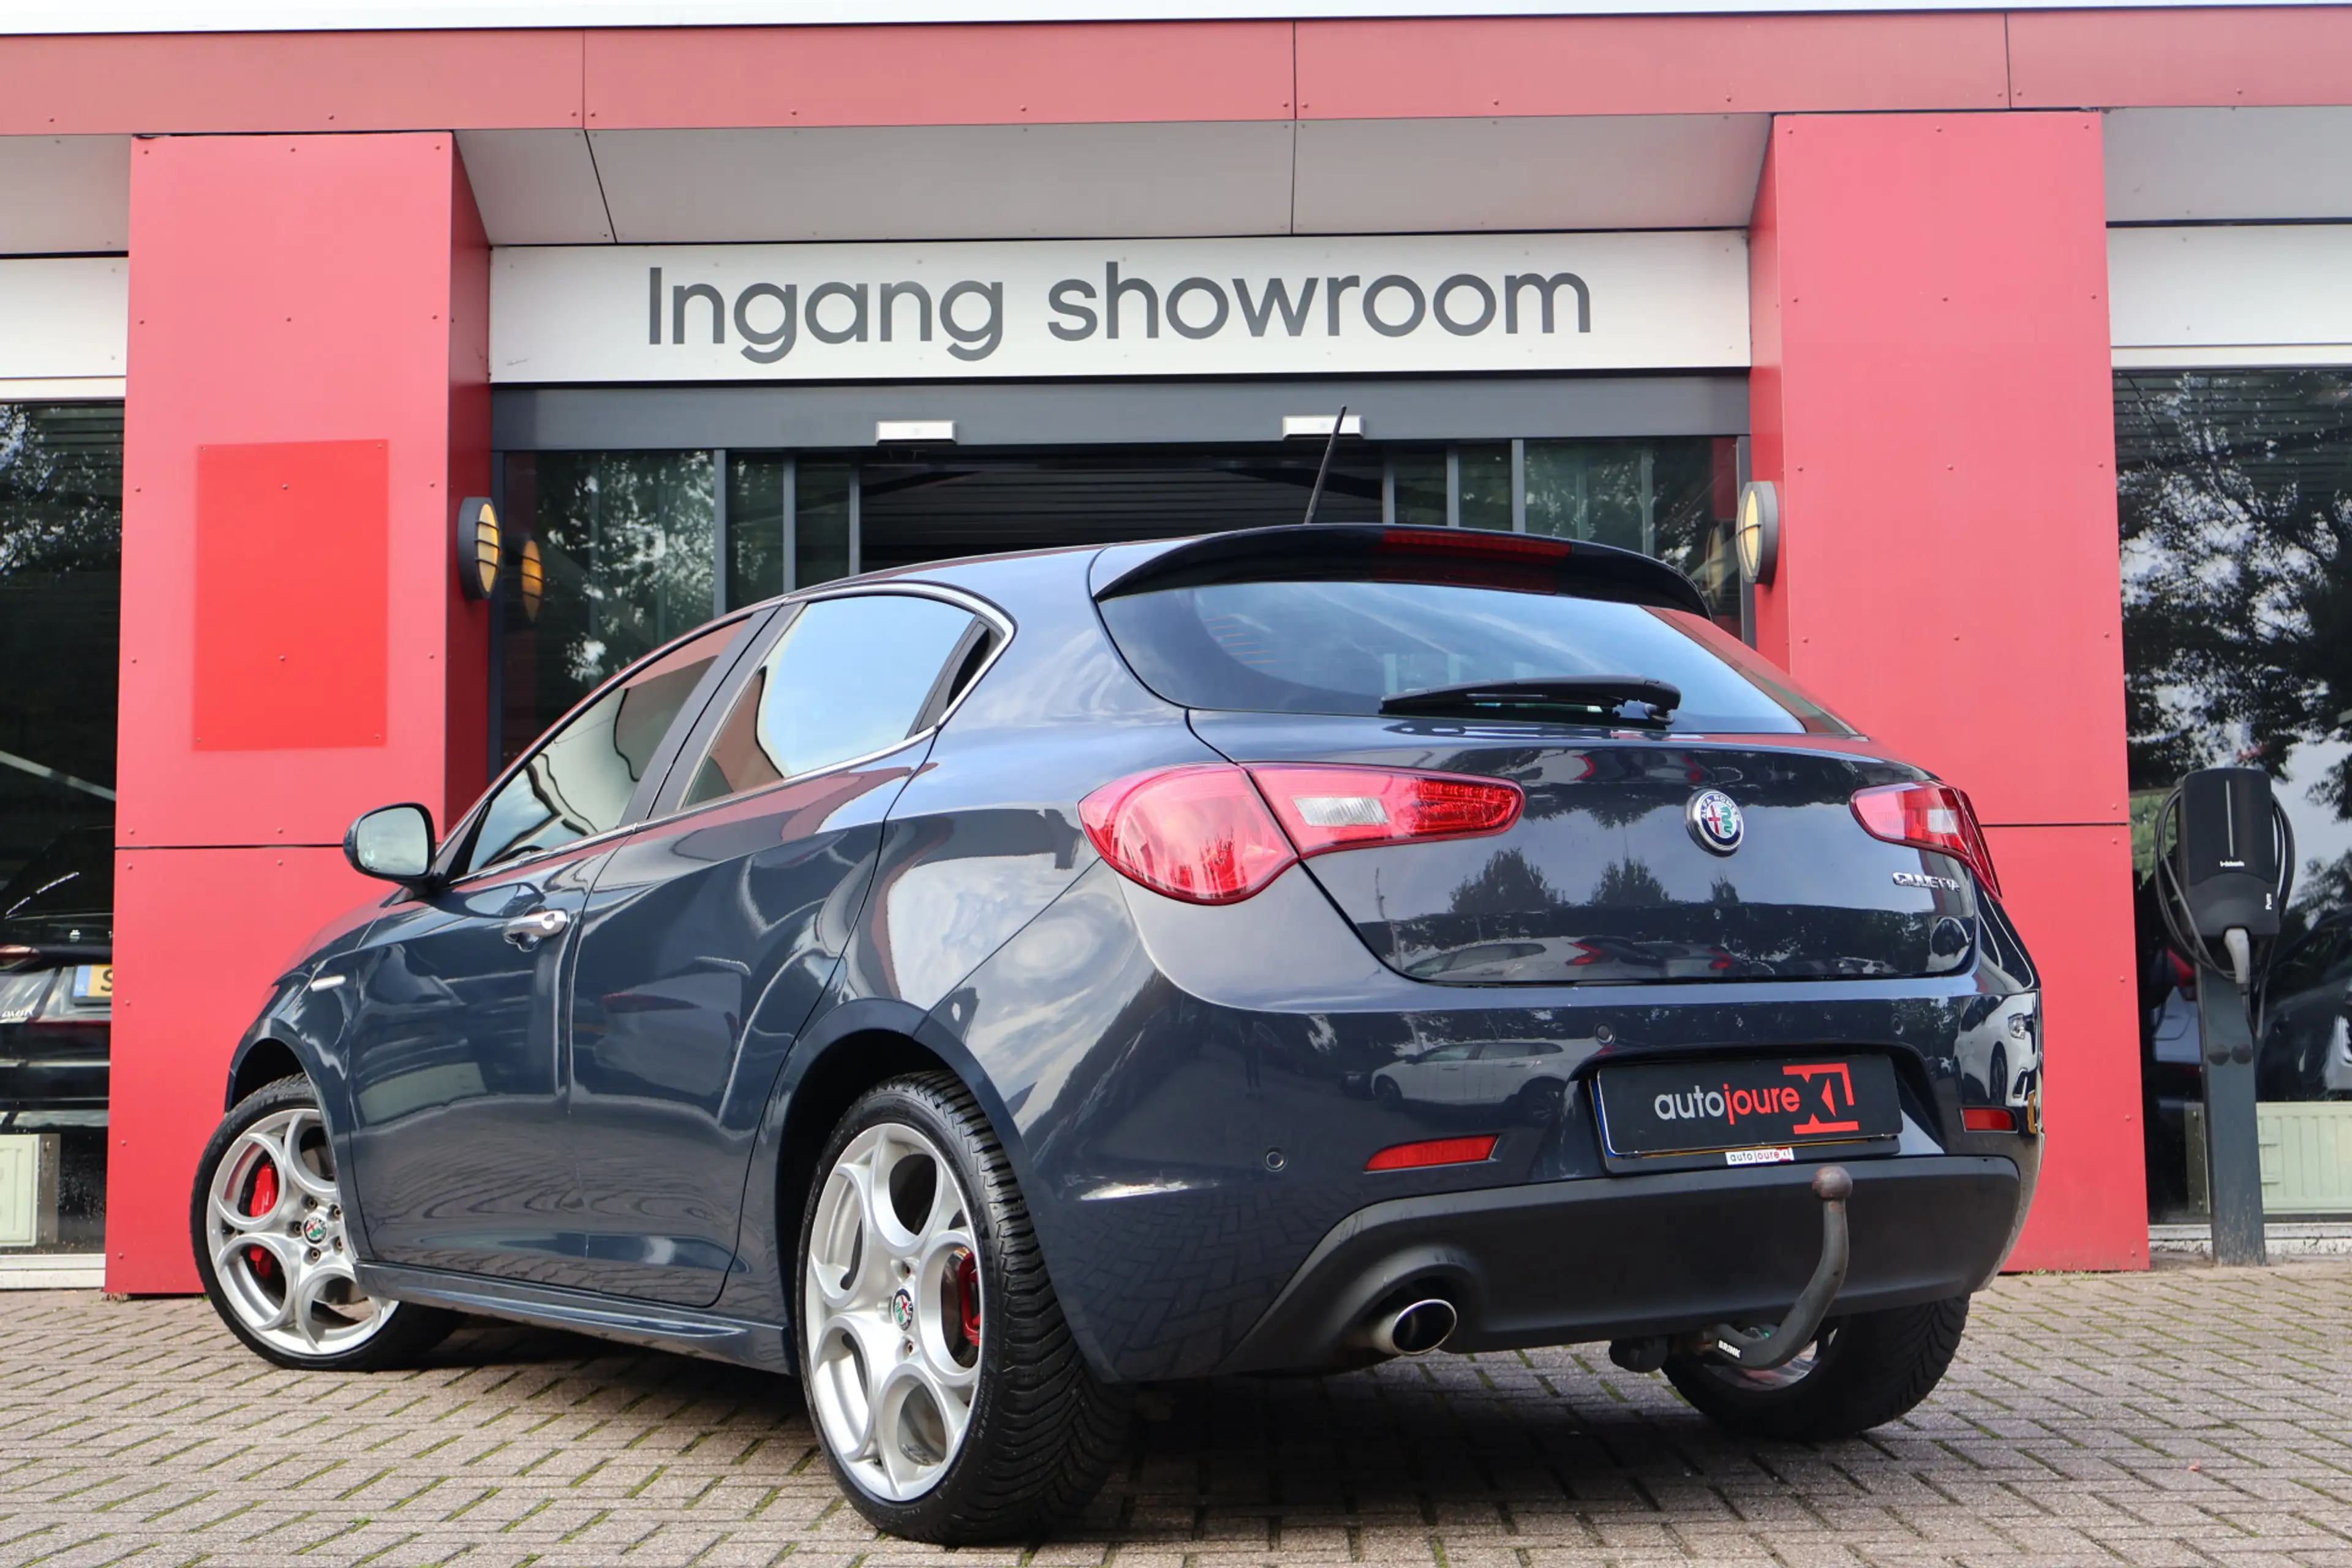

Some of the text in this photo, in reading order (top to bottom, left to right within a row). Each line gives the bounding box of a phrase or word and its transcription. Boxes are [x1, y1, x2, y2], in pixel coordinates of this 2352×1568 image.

[649, 261, 1590, 363] Ingang showroom
[1654, 1083, 1801, 1125] autojoure
